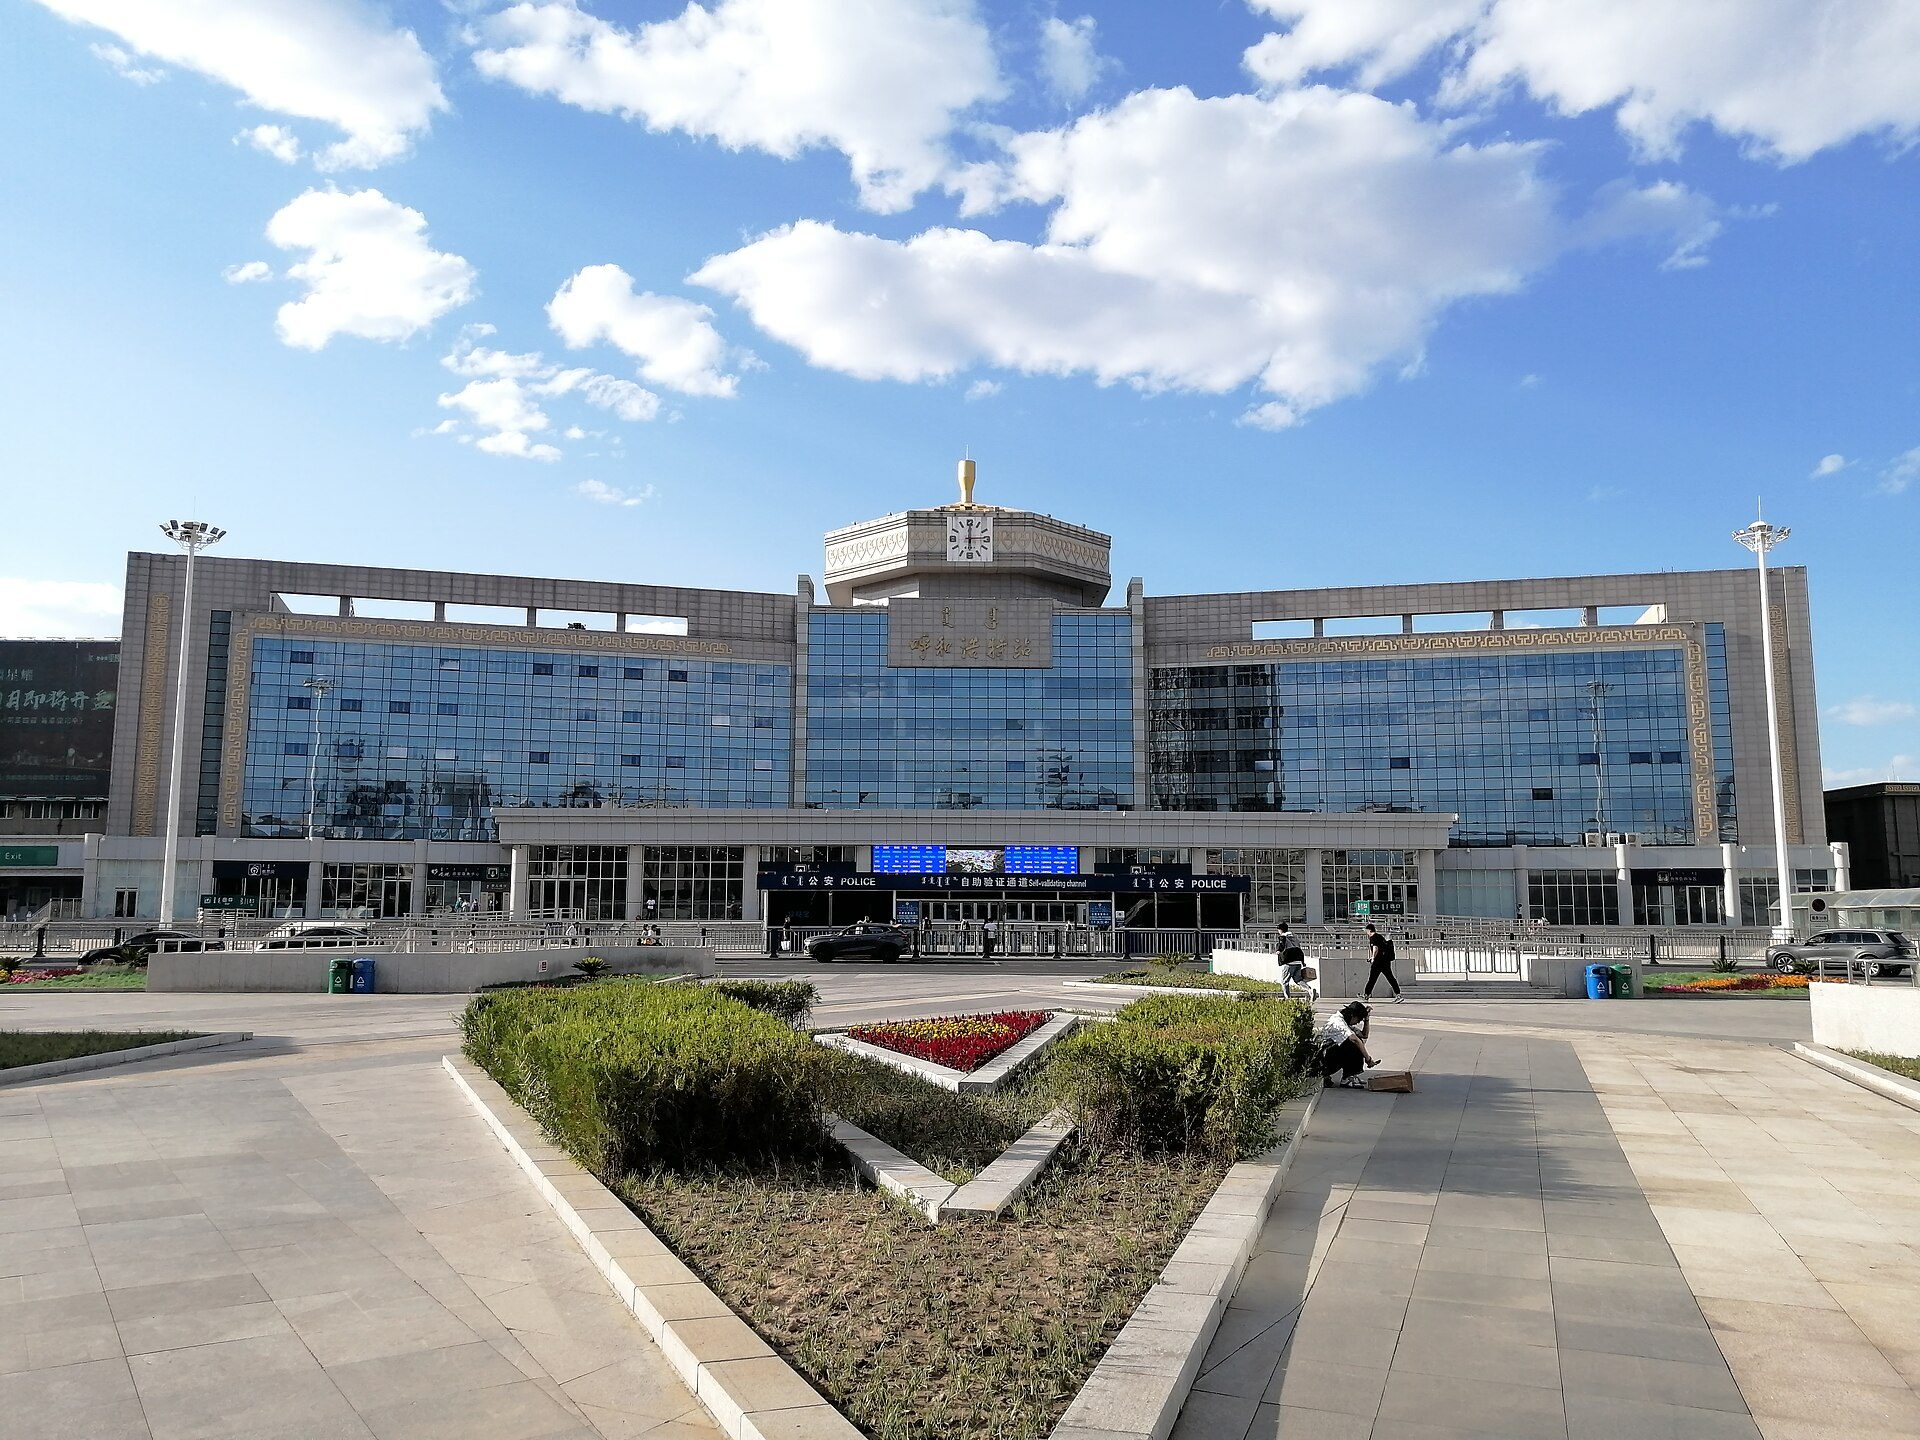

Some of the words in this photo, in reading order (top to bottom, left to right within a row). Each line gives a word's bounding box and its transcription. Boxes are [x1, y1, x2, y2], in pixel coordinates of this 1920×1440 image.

[908, 635, 1033, 661] 呼和浩特站
[0, 688, 114, 712] 月即将开盘
[5, 852, 22, 860] Exit
[808, 875, 834, 886] 公安
[840, 877, 876, 886] POLICE
[961, 876, 1029, 888] 自助验证通道
[1028, 879, 1066, 889] Self-validating
[1066, 878, 1087, 888] channel
[1159, 878, 1185, 889] 公安
[1191, 879, 1227, 889] POLICE
